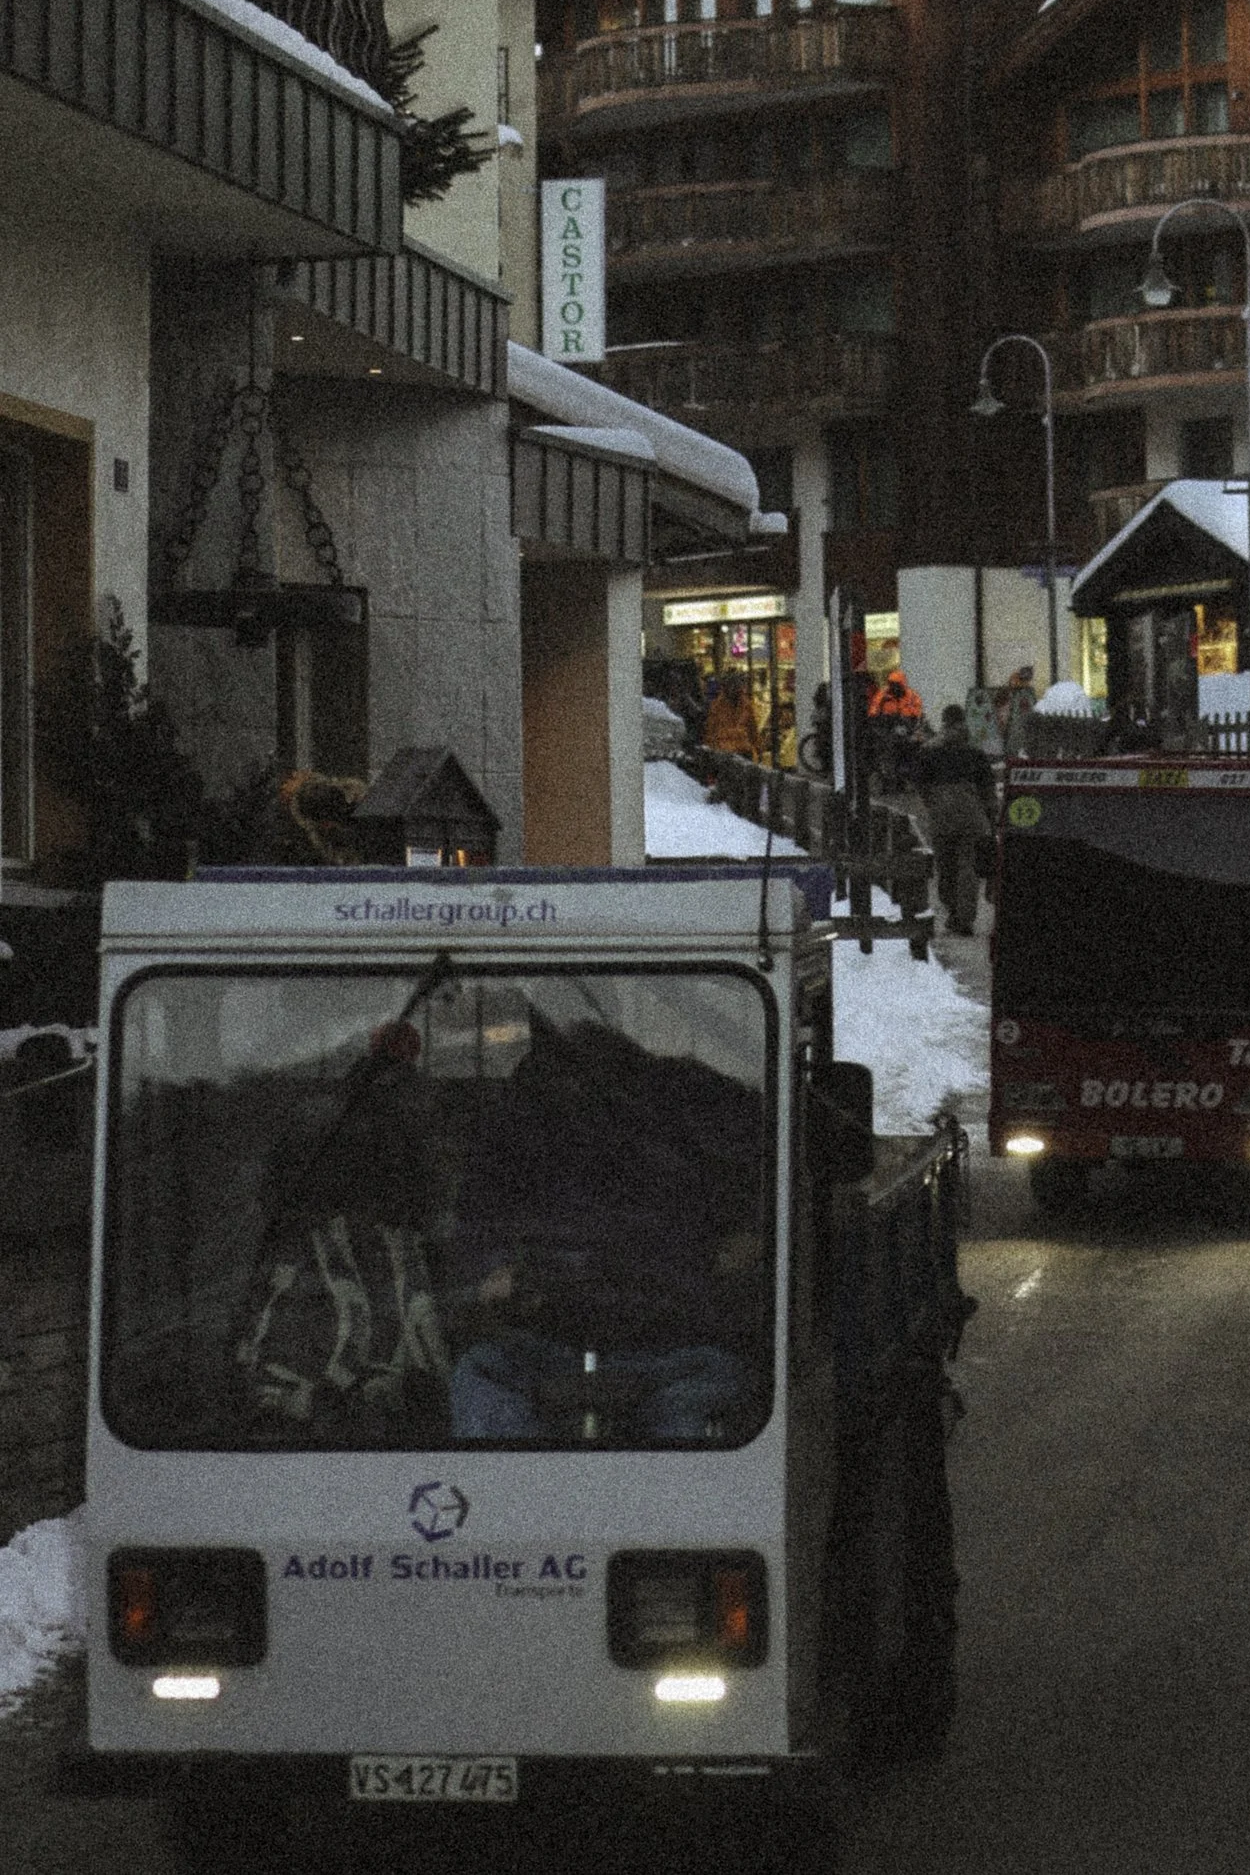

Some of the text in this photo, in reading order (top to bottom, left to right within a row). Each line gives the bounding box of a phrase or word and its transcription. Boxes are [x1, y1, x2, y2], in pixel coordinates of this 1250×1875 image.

[560, 187, 585, 353] CASTOR
[335, 898, 557, 927] schallergroup.ch
[1080, 1079, 1225, 1110] BOLERO
[283, 1554, 588, 1580] Adolf Schaller AG
